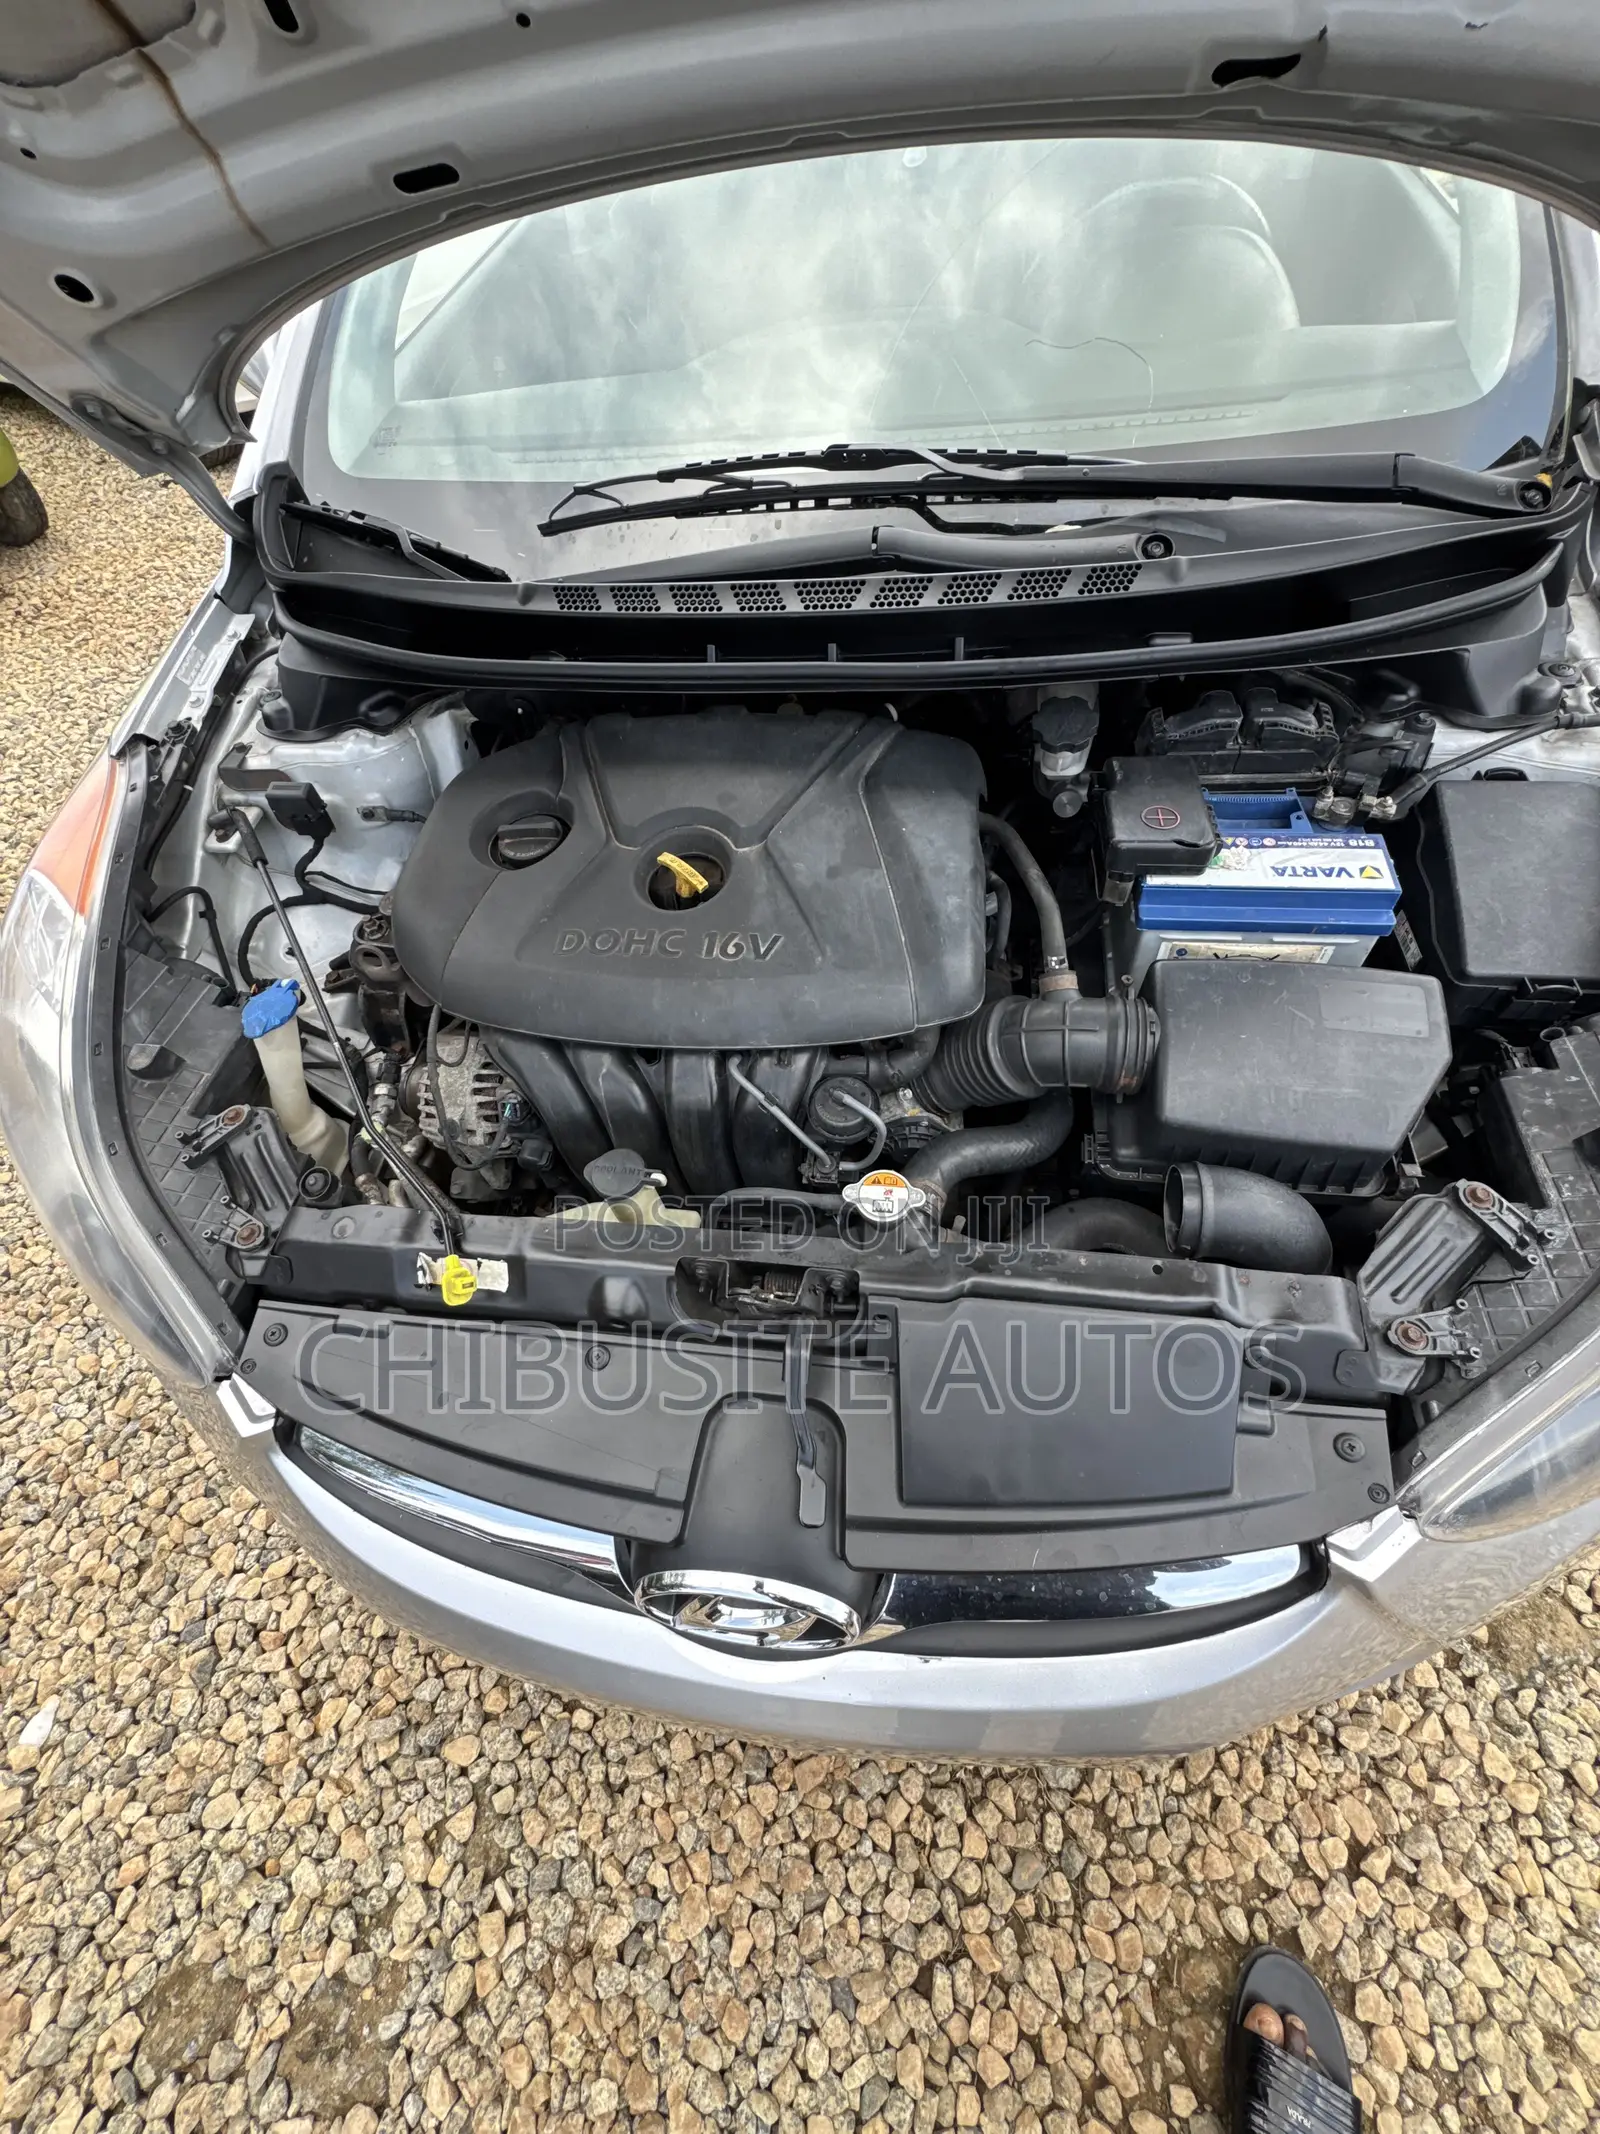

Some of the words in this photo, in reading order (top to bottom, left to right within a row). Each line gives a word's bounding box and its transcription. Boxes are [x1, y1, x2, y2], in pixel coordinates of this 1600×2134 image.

[1270, 866, 1355, 878] VARTA
[554, 928, 687, 959] DOHC
[700, 930, 784, 961] 16V
[594, 1165, 643, 1176] COOLANT
